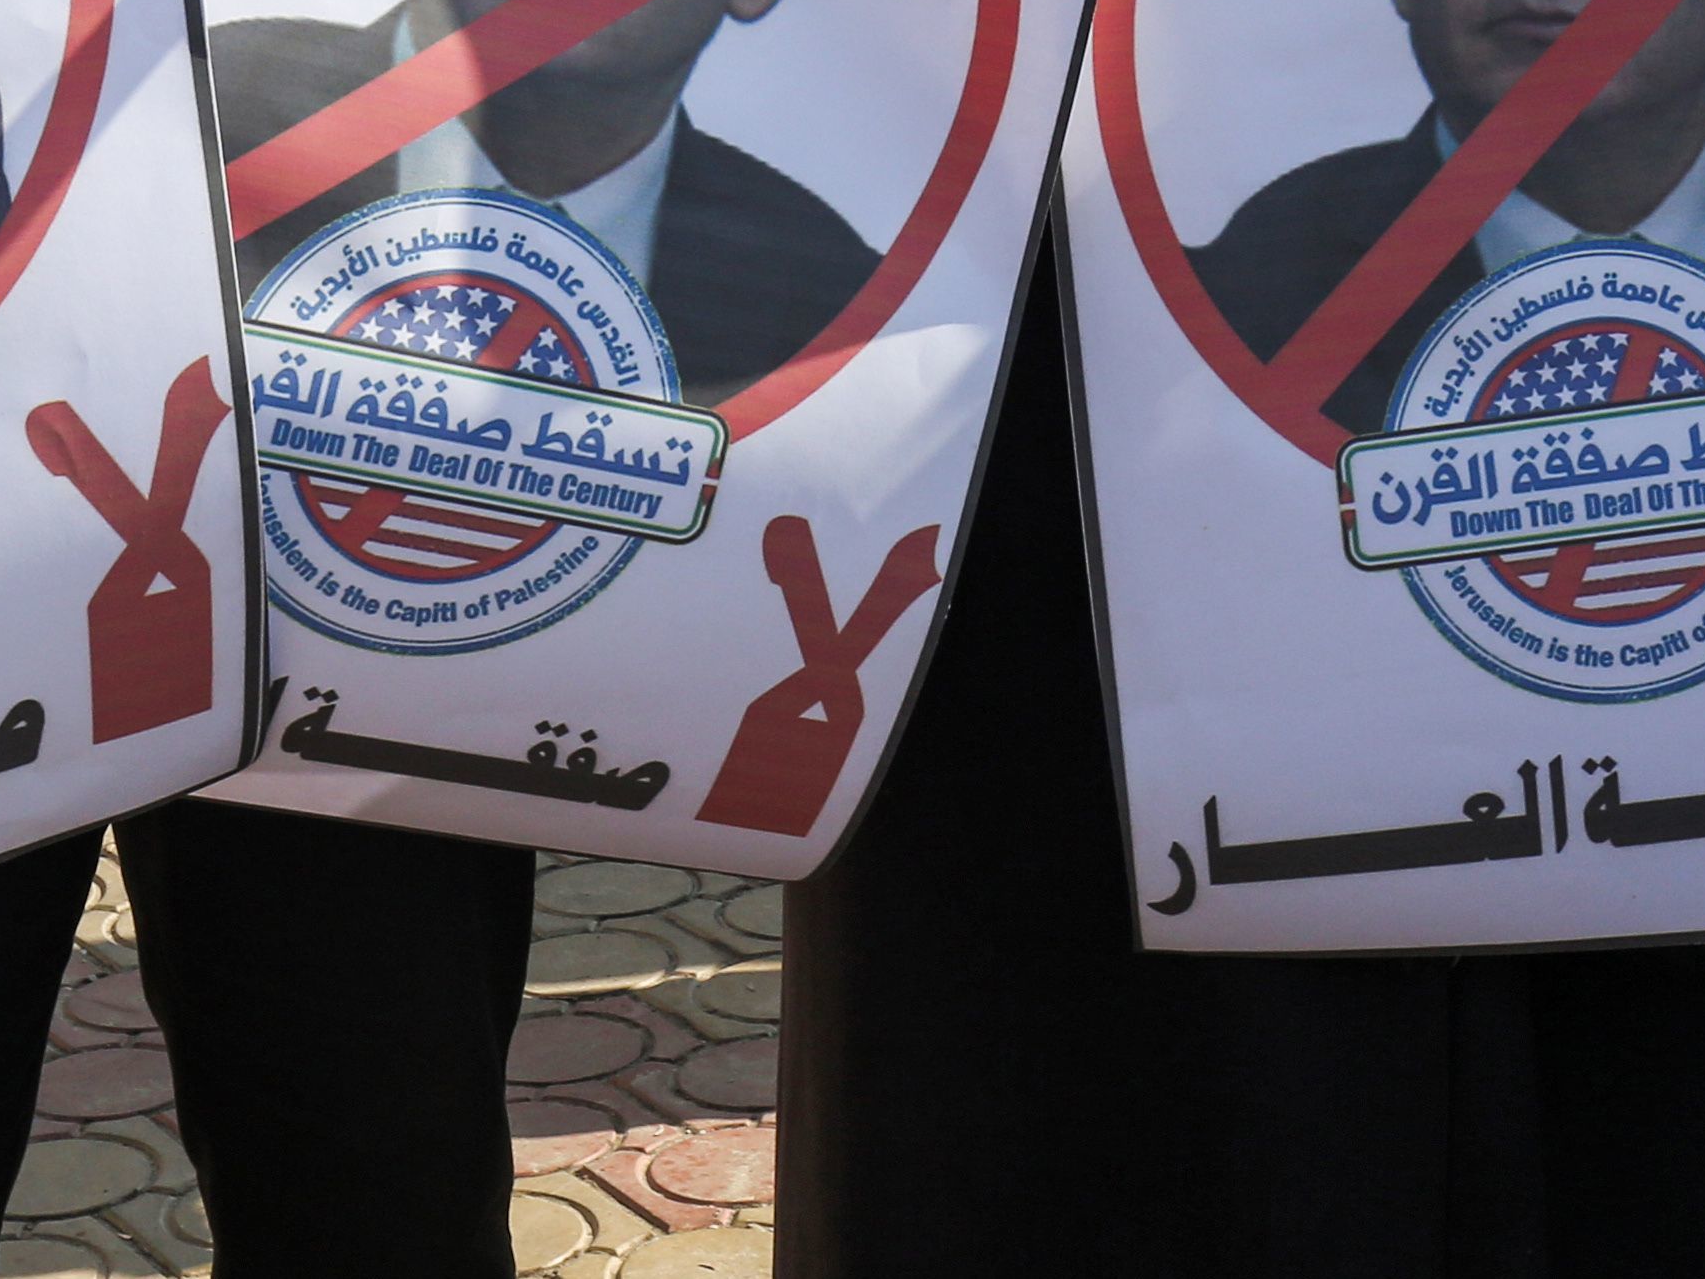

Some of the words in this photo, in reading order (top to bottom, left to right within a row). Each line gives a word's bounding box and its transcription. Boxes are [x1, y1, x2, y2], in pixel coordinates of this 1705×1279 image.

[290, 242, 381, 322] الأبدية
[384, 225, 500, 267] فلسطين
[505, 230, 585, 300] عاصمة
[1491, 275, 1596, 345] فلسطين
[1600, 271, 1686, 315] عاصمة
[577, 298, 643, 388] القدس
[1423, 326, 1491, 419] الأبدية
[252, 349, 342, 419] القر
[345, 373, 513, 453] صفقة
[270, 418, 346, 459] Down
[351, 433, 398, 468] The
[408, 444, 468, 482] Deal
[473, 457, 504, 487] Of
[506, 463, 553, 499] The
[557, 473, 663, 520] Century
[520, 410, 694, 487] تسقط
[1371, 446, 1499, 528] القرن
[1510, 427, 1671, 497] صفقة
[1450, 502, 1523, 539] Down
[1524, 492, 1575, 530] The
[1584, 485, 1644, 521] Deal
[1647, 481, 1674, 511] Of
[315, 572, 340, 598] is
[341, 583, 381, 617] the
[384, 598, 459, 628] Capitl
[463, 594, 492, 621] of
[495, 534, 601, 612] Palestine
[1444, 563, 1544, 656] Jerusalem
[1546, 637, 1570, 664] is
[1573, 642, 1616, 670] the
[1619, 629, 1692, 669] Capitl
[280, 684, 672, 813] صفقة
[1145, 752, 1570, 918] العار
